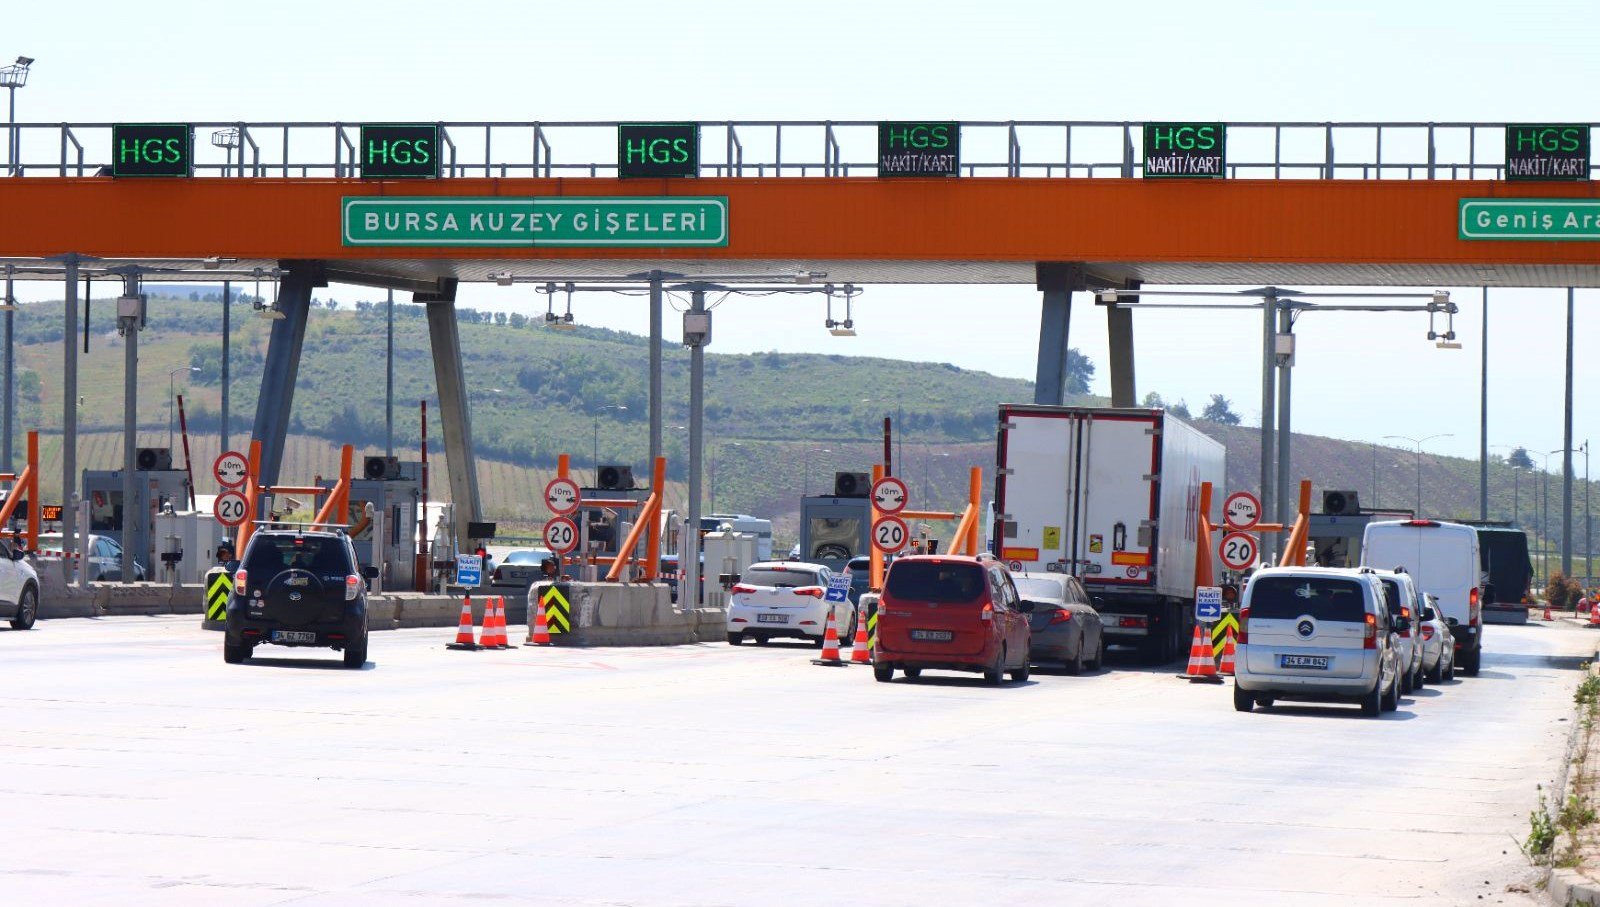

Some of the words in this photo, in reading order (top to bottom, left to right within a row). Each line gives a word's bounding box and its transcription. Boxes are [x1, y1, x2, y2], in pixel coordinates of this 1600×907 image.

[890, 126, 949, 148] HGS
[1155, 127, 1216, 150] HGS
[1517, 128, 1579, 152] HGS
[121, 139, 180, 164] HGS
[369, 139, 430, 164] HGS
[627, 139, 688, 164] HGS
[883, 151, 956, 172] NAKİT/KART
[1146, 151, 1221, 174] NAKİT/KART
[1509, 154, 1586, 177] NAKİT/KART
[365, 212, 459, 231] BURSA
[470, 212, 562, 231] KUZEY
[573, 208, 705, 235] GİŞELERİ
[1477, 211, 1553, 231] Geniş
[224, 461, 242, 470] 10m
[554, 488, 572, 496] 10m
[881, 488, 899, 496] 10m
[222, 501, 244, 518] 20
[1234, 502, 1252, 511] 10m
[551, 526, 572, 543] 20
[879, 526, 902, 544] 20
[1226, 541, 1249, 561] 20
[1313, 657, 1326, 666] 842
